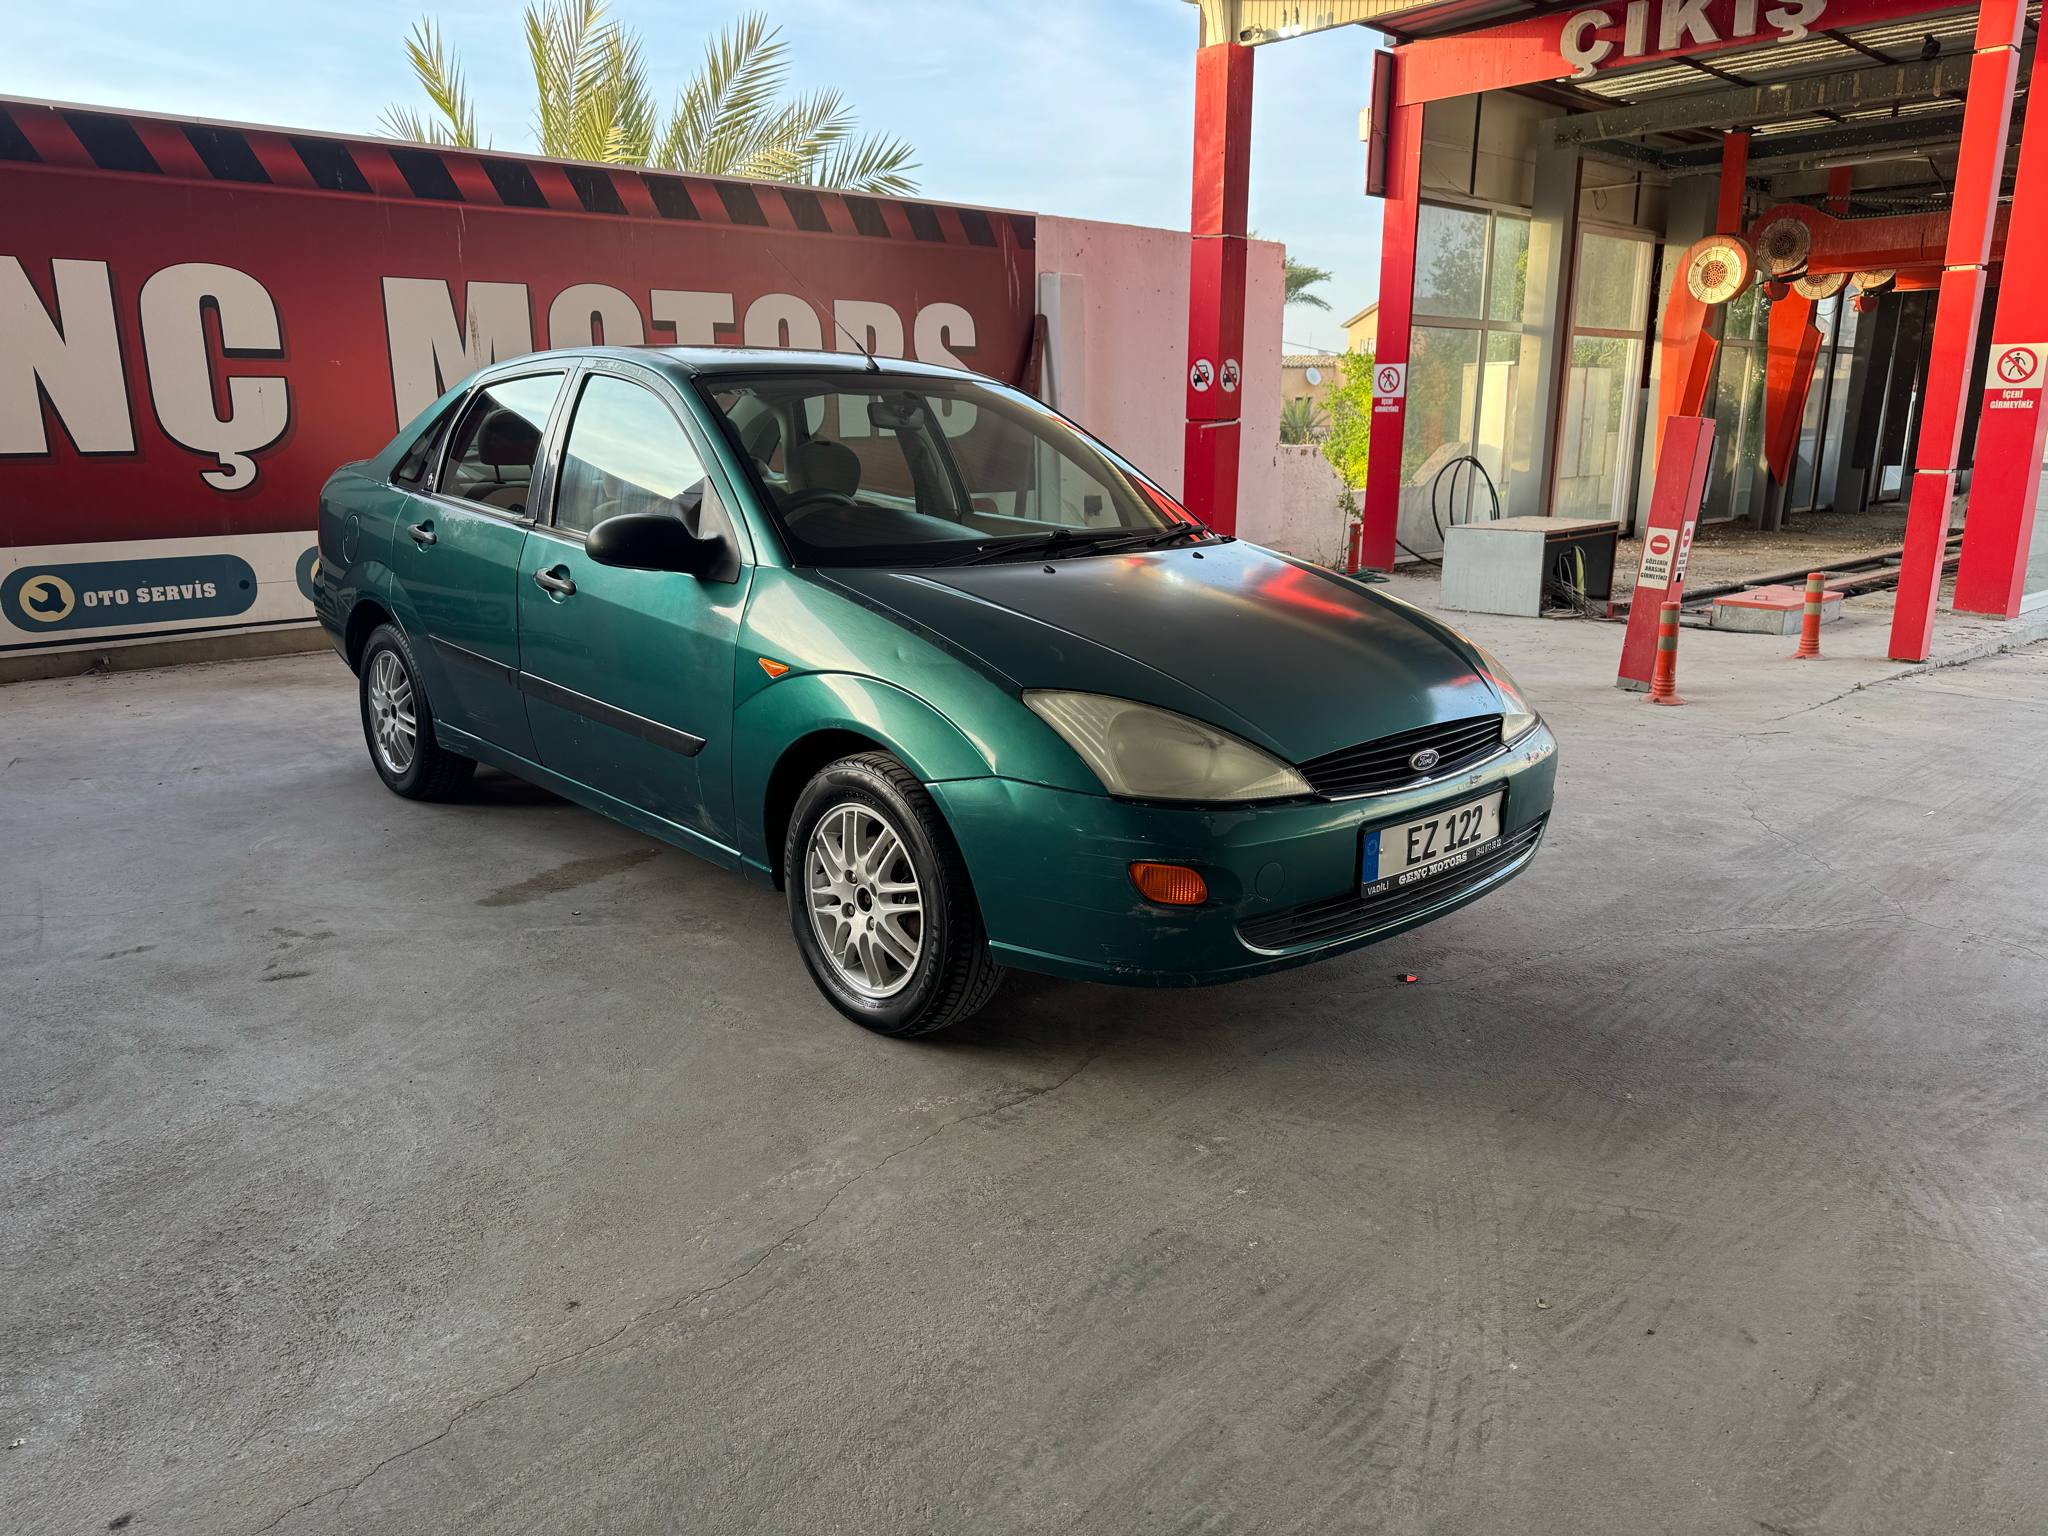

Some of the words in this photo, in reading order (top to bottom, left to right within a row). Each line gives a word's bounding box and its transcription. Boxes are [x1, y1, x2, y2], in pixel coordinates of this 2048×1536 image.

[1989, 399, 2034, 409] GİRMEYİNİZ
[2002, 389, 2024, 400] İÇERİ
[83, 589, 129, 607] OTO
[136, 580, 217, 603] SERVİS
[1406, 820, 1439, 866] EZ
[1444, 804, 1483, 852] 122
[1398, 865, 1428, 885] GENÇ
[1429, 851, 1468, 875] MOTORS
[1367, 881, 1390, 896] VADİLİ
